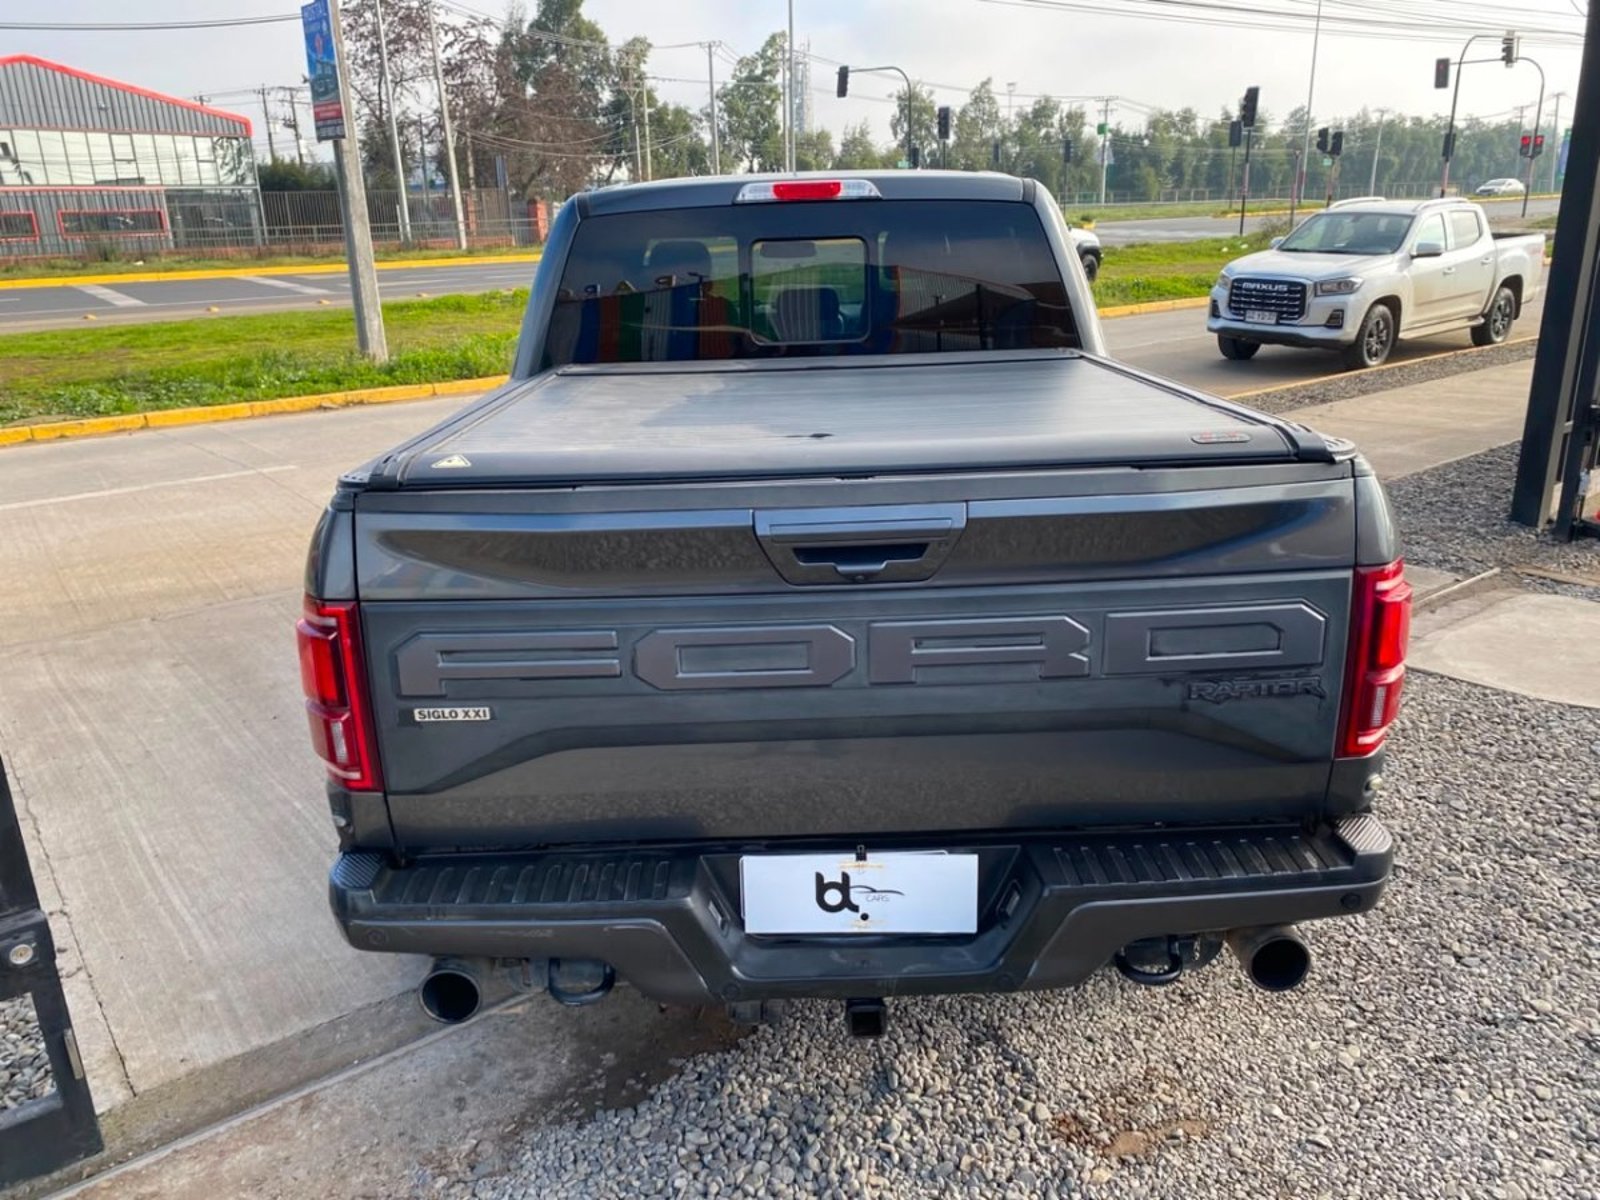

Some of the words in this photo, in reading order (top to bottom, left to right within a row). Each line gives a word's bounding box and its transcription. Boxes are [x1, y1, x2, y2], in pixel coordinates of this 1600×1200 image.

[1242, 282, 1288, 291] MAXUS
[396, 601, 1325, 697] FORD
[1188, 676, 1327, 703] RAPTOR
[418, 710, 459, 720] SIGLO
[461, 708, 488, 719] XXI
